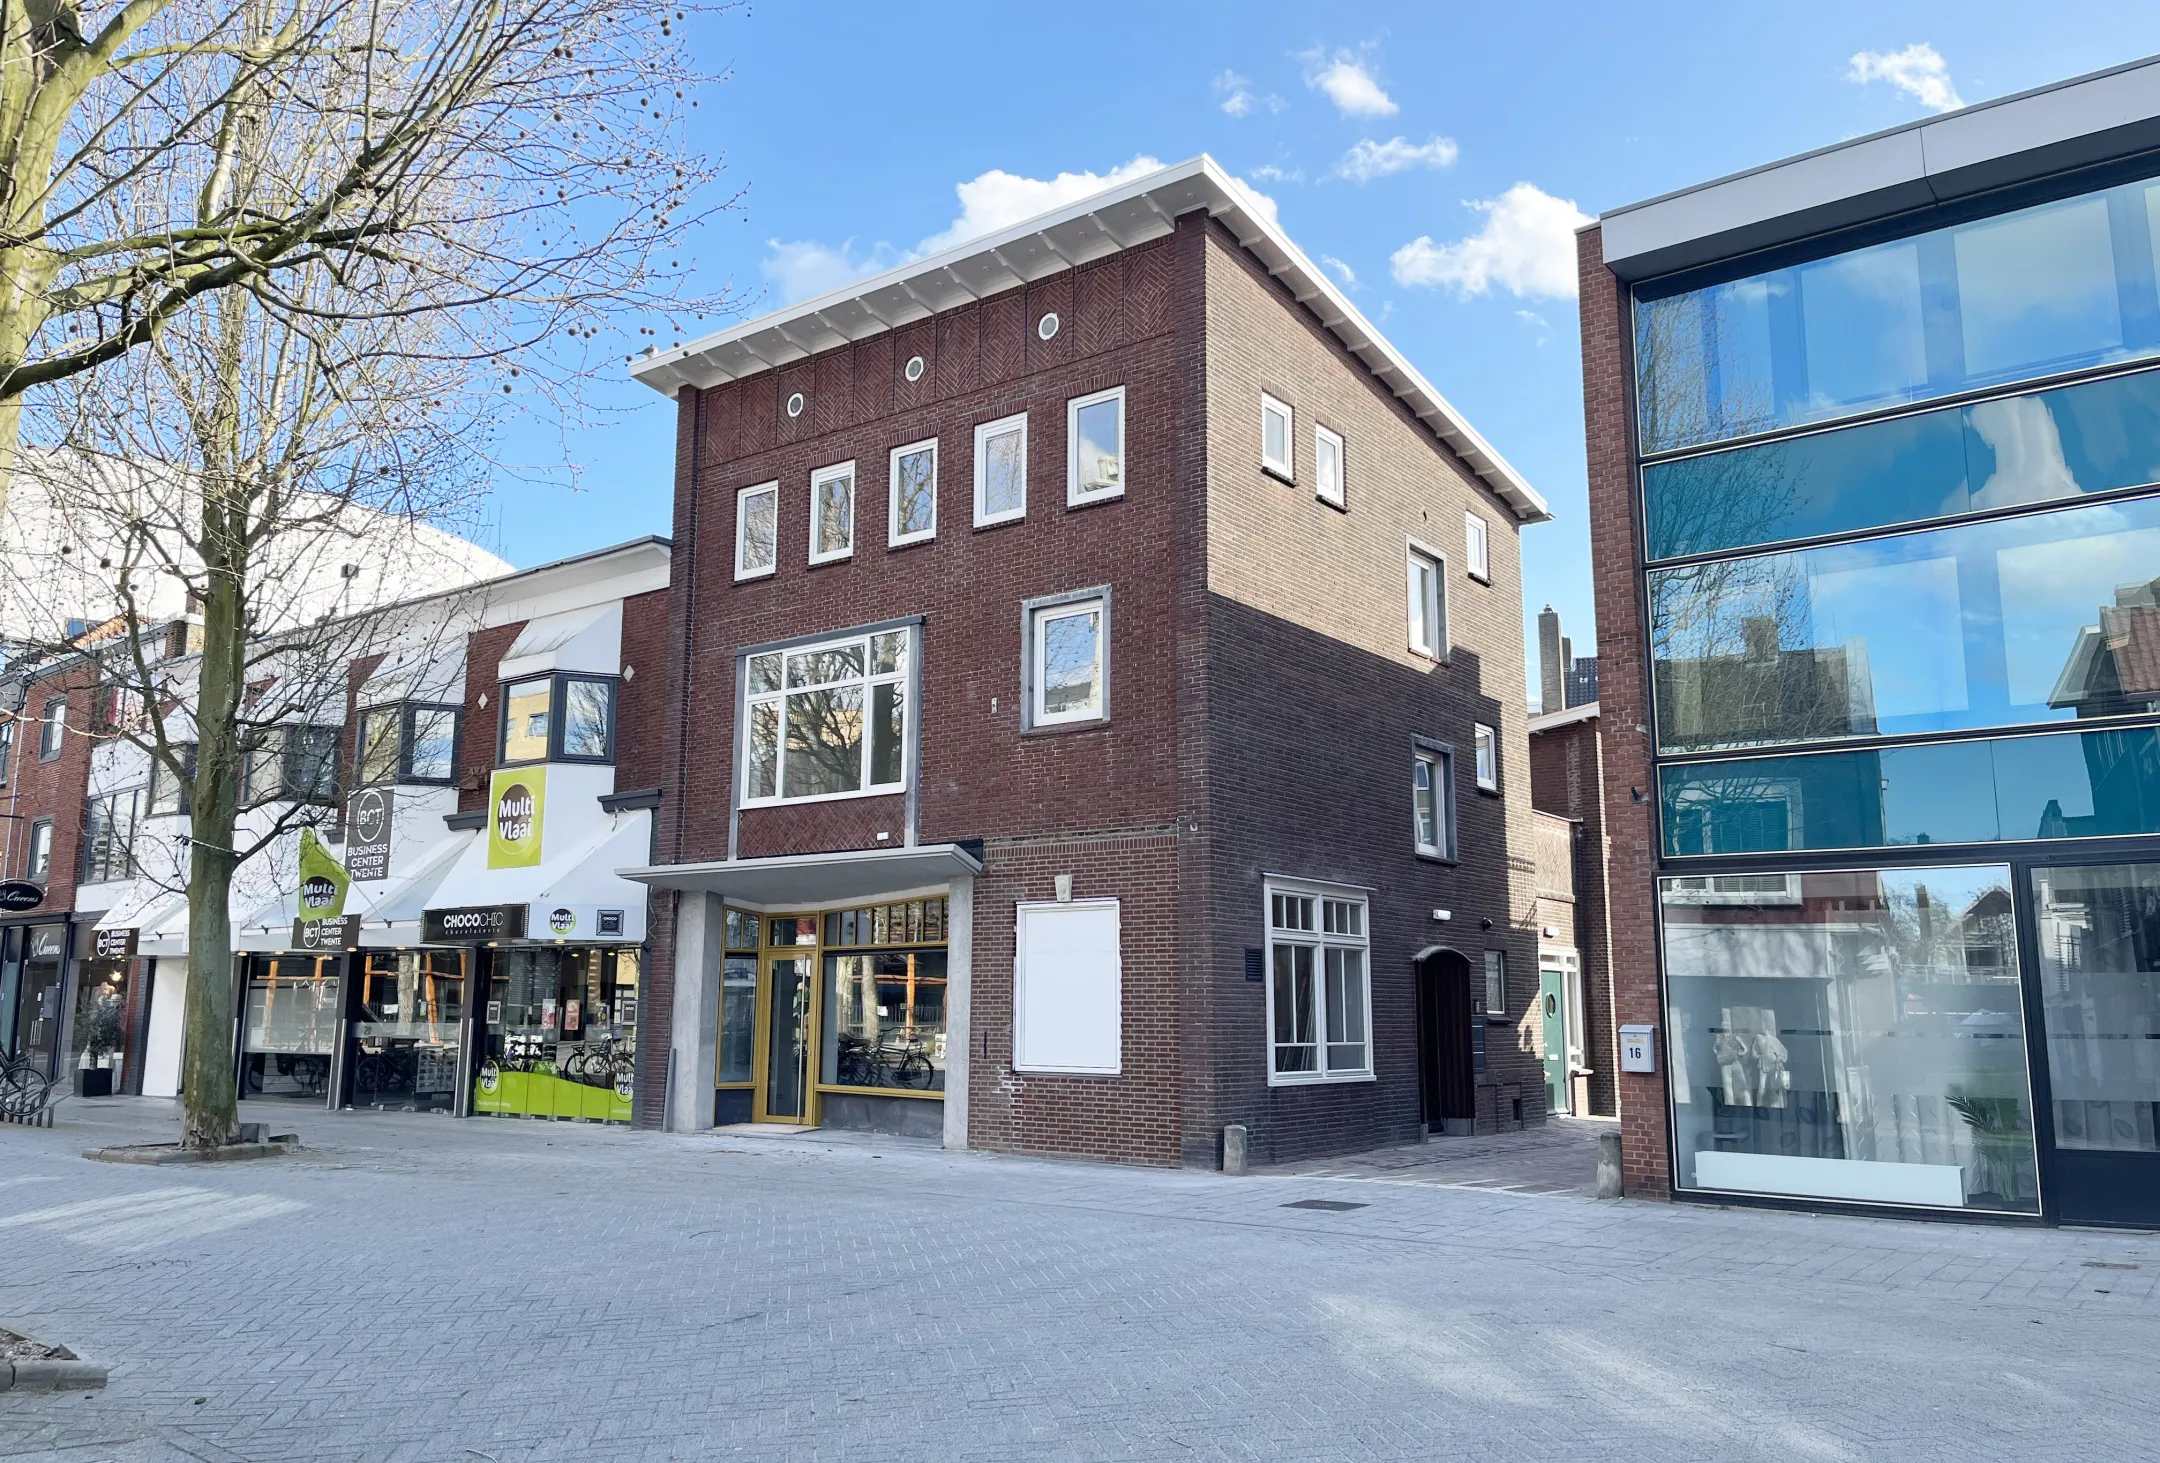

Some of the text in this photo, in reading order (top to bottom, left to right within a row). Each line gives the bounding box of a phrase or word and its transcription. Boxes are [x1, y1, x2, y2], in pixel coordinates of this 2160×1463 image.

[499, 795, 535, 817] Multi
[359, 808, 382, 825] BCT
[500, 818, 532, 840] Vlaai
[347, 843, 388, 857] BUSINESS
[351, 855, 384, 868] CENTER
[350, 867, 384, 879] TWENTE
[303, 883, 338, 896] Multi
[304, 895, 335, 909] Vlaai
[321, 916, 348, 926] BUSINESS
[443, 911, 504, 928] CHOCOCHIC
[551, 913, 574, 922] Multi
[320, 927, 342, 936] CENTER
[551, 921, 573, 930] Vlaai
[304, 927, 319, 938] BCT
[320, 937, 342, 946] TWENTE
[1629, 1047, 1642, 1059] 16
[481, 1067, 498, 1077] Mult
[616, 1072, 635, 1083] Mult
[616, 1084, 634, 1095] Vlaa
